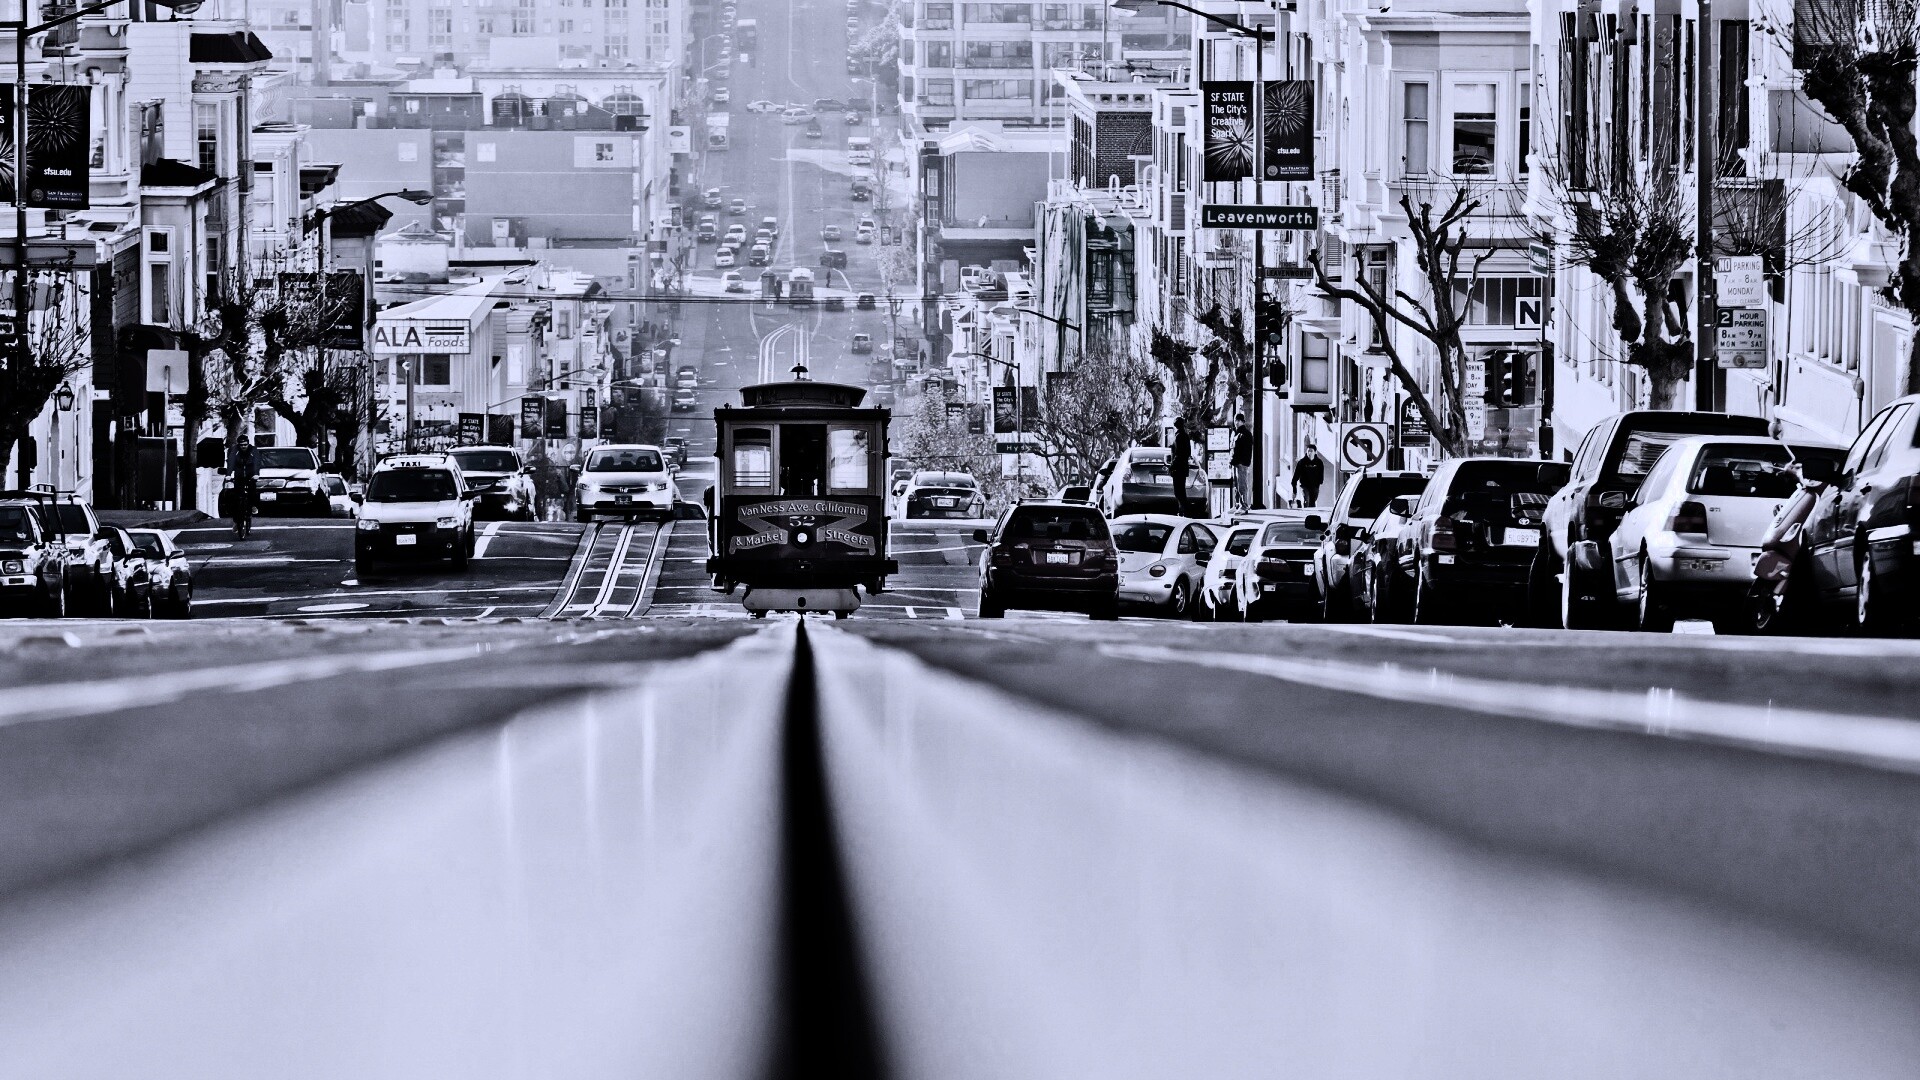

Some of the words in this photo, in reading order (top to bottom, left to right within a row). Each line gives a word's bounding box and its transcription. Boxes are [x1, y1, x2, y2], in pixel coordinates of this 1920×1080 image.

[1211, 93, 1220, 102] SF
[1222, 92, 1245, 102] STATE
[1211, 105, 1225, 114] The
[1226, 104, 1247, 115] City's
[1211, 117, 1244, 126] Creative
[1211, 129, 1234, 139] Spark
[1277, 147, 1300, 155] sfsu.edu
[43, 167, 72, 176] sfsu.edu
[1207, 210, 1313, 225] Leavenworth
[1718, 258, 1731, 272] NO
[1733, 261, 1761, 270] PARKING
[1266, 268, 1312, 278] LEAVENWORTH
[1727, 287, 1754, 295] MONDAY
[1720, 311, 1730, 324] 2
[1734, 320, 1765, 328] PARKING
[427, 336, 465, 347] Foods
[1750, 340, 1763, 348] SAT
[1465, 364, 1483, 372] ARKING
[740, 506, 759, 516] Van
[760, 503, 785, 514] Ness
[815, 502, 867, 516] California
[789, 515, 816, 527] 52
[736, 536, 743, 546] &
[745, 532, 784, 547] Market
[825, 529, 868, 545] Streets
